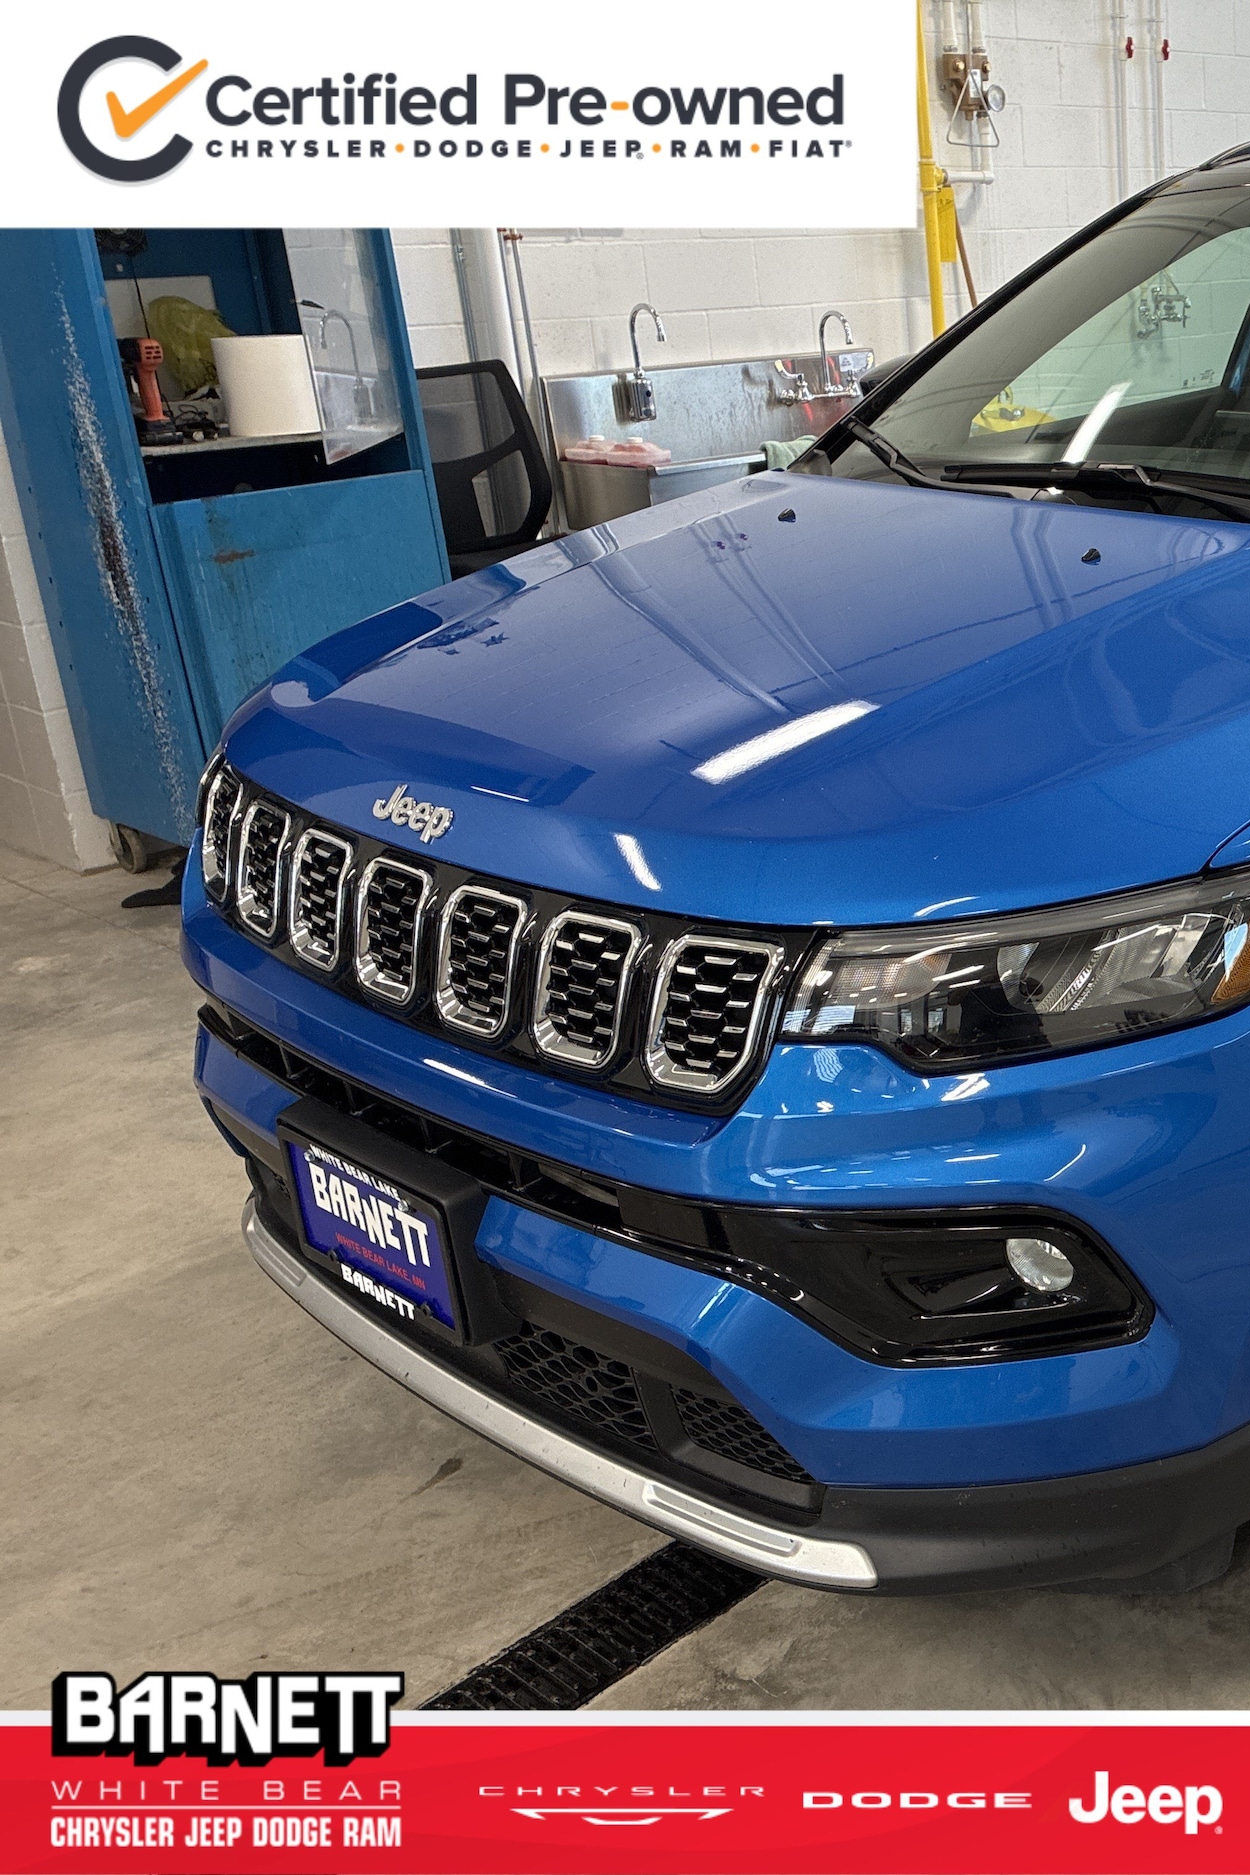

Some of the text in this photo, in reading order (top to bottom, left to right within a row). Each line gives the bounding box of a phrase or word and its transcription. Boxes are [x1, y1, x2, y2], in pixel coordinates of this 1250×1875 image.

[373, 784, 454, 844] Jeep
[310, 1144, 401, 1202] WHITE BEAR LAKE
[309, 1162, 430, 1268] BARNETT
[336, 1232, 361, 1255] WHITE
[361, 1246, 386, 1268] BEAR
[340, 1263, 416, 1321] BARNETT
